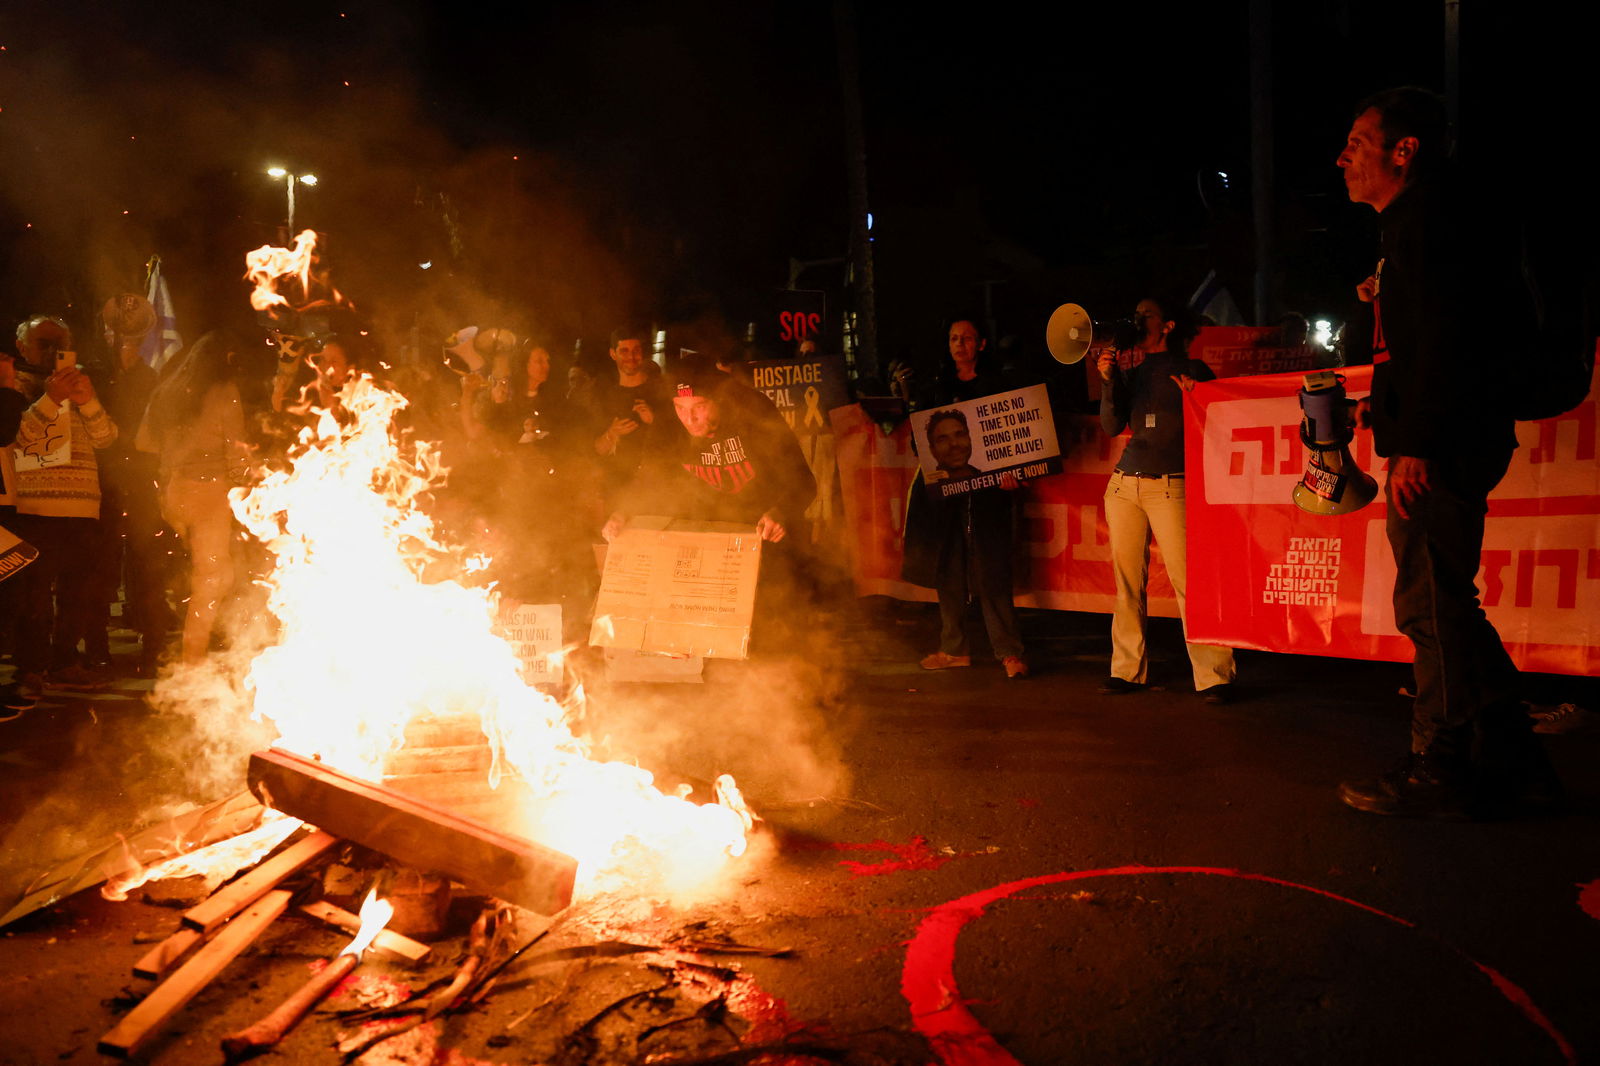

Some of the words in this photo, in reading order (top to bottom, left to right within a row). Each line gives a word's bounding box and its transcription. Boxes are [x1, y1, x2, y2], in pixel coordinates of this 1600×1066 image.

[780, 311, 820, 341] SOS
[753, 363, 822, 388] HOSTAGE
[760, 388, 795, 408] EAL
[976, 405, 990, 418] HE
[991, 401, 1010, 415] HAS
[1011, 397, 1025, 410] NO
[979, 418, 1003, 432] TIME
[1005, 415, 1016, 426] TO
[1017, 408, 1043, 422] WAIT.
[983, 431, 1011, 447] BRING
[1013, 426, 1031, 440] HIM
[986, 447, 1013, 462] HOME
[1015, 438, 1044, 455] ALIVE!
[941, 481, 970, 497] BRING
[971, 474, 995, 490] OFER
[1023, 462, 1049, 479] NOW!
[1290, 537, 1341, 551] מחאת
[1287, 551, 1341, 565] הנשים
[1270, 564, 1340, 579] להחזרת
[1266, 576, 1338, 592] החטופות
[1263, 591, 1337, 606] והחטופים
